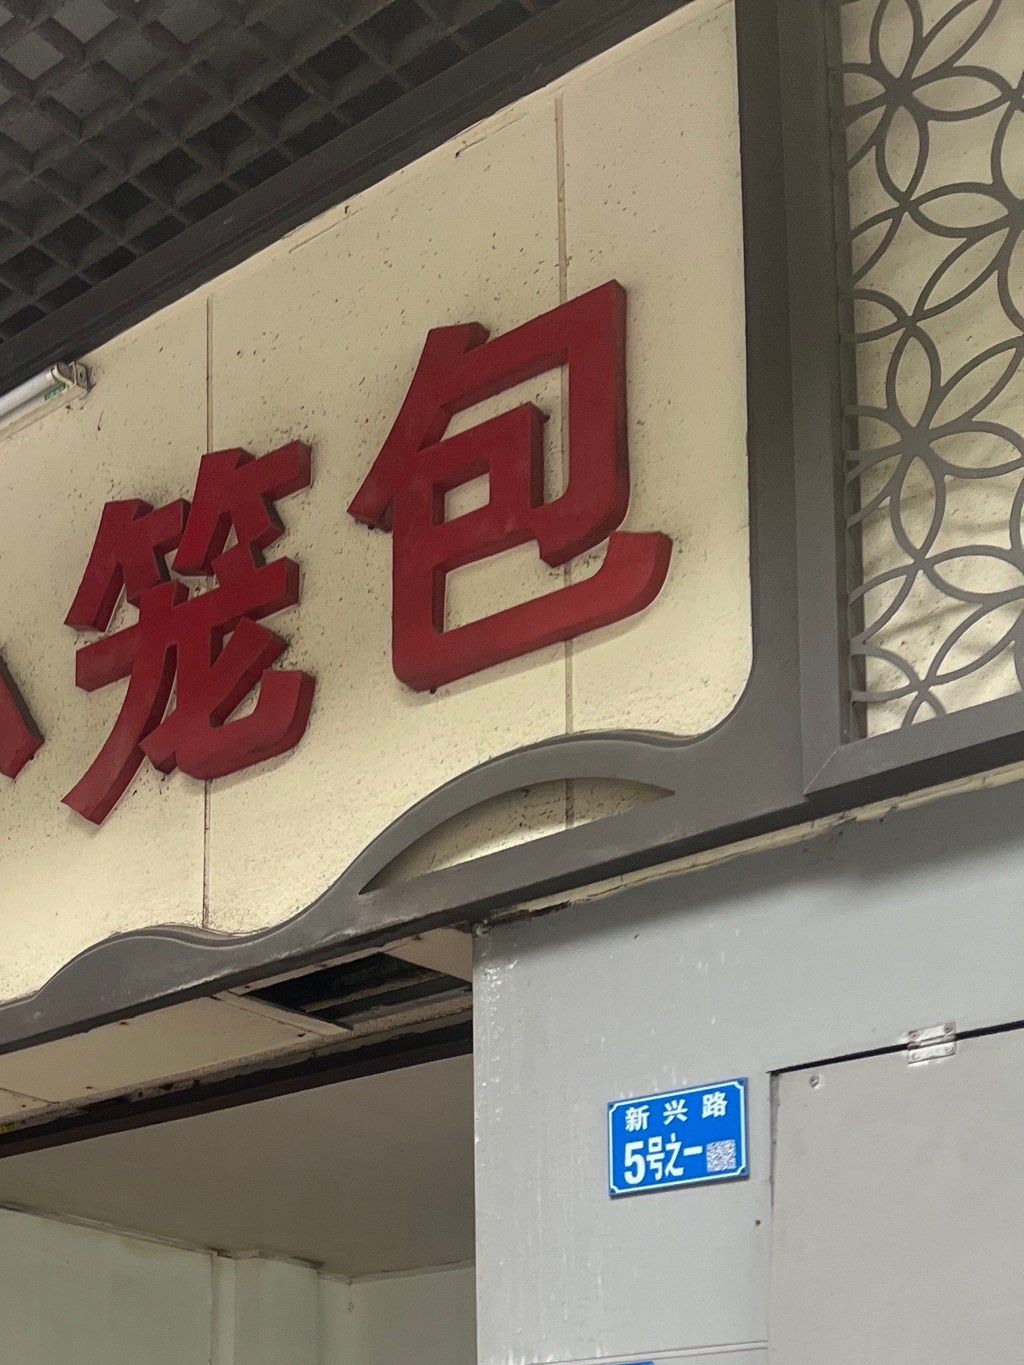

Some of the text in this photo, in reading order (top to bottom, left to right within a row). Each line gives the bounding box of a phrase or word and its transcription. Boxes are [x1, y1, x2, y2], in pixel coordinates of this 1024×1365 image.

[625, 1091, 728, 1131] 新兴路
[624, 1133, 703, 1185] 5号之一
